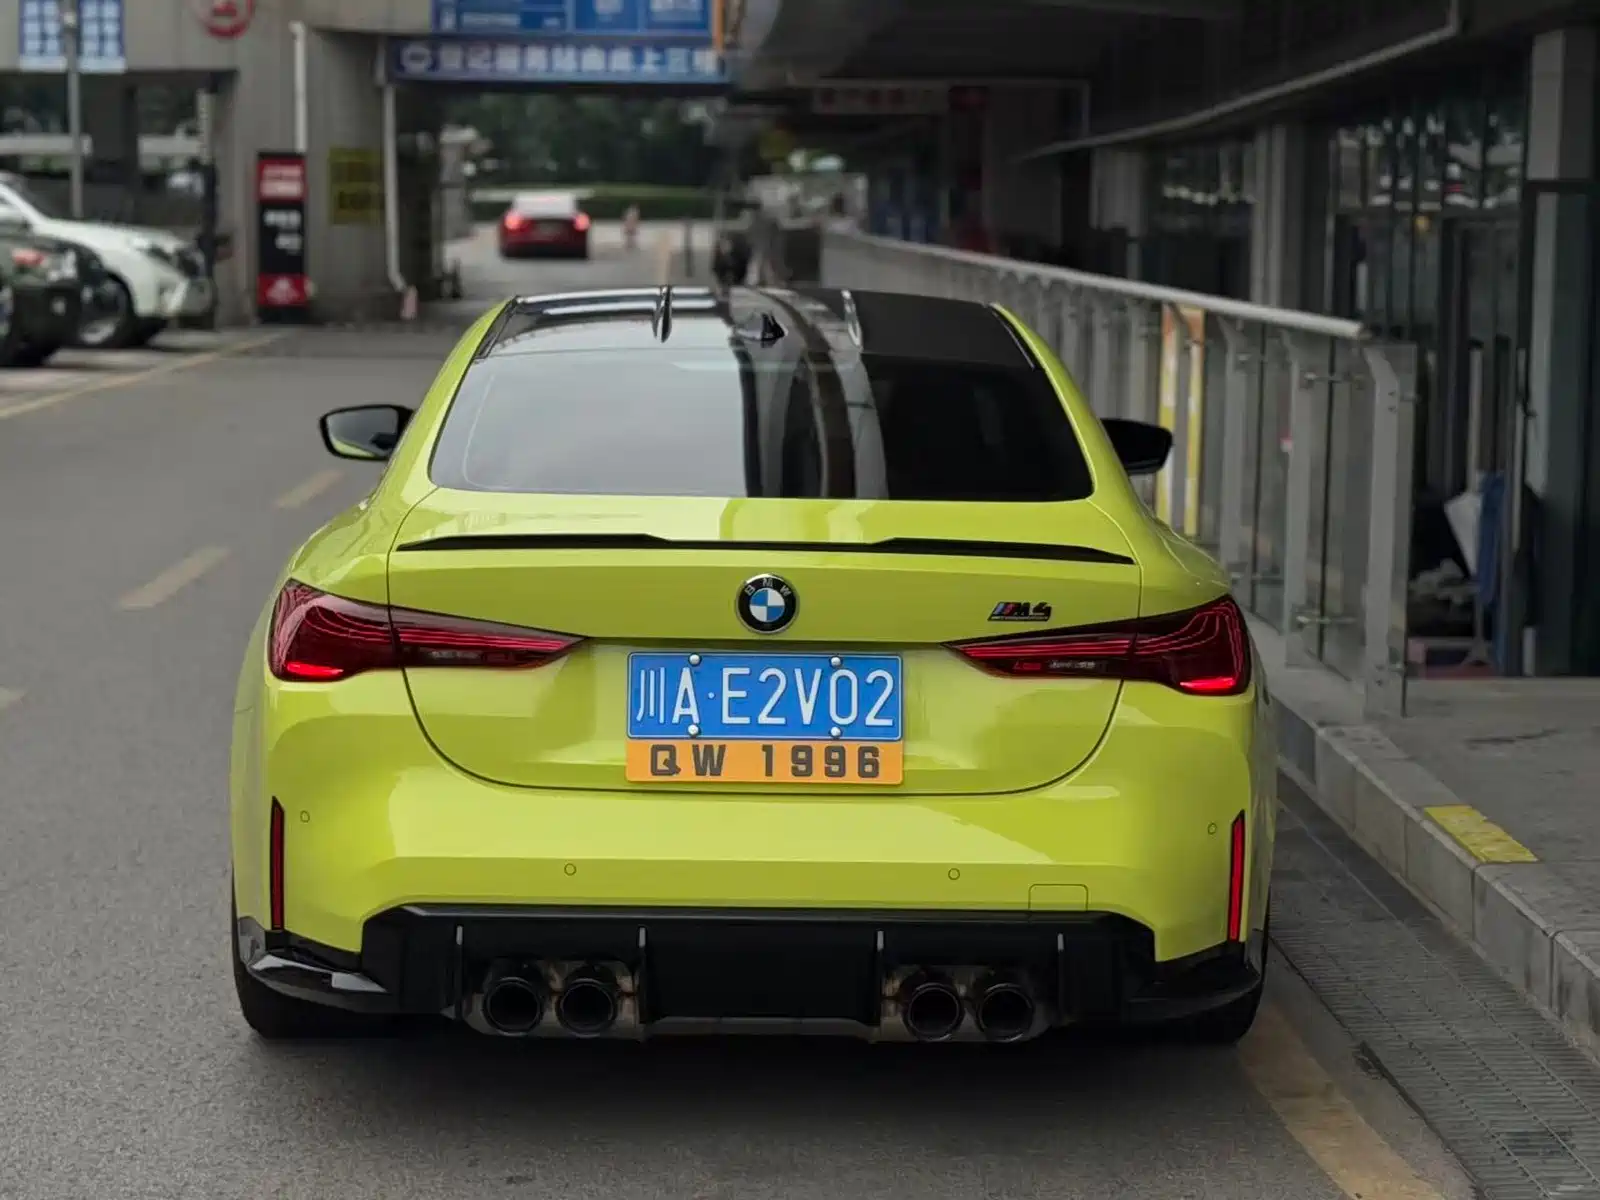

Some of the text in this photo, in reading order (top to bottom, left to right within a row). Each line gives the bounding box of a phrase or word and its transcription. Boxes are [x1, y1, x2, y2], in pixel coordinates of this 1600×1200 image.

[745, 577, 792, 597] BMW
[650, 744, 880, 778] QW 1996
